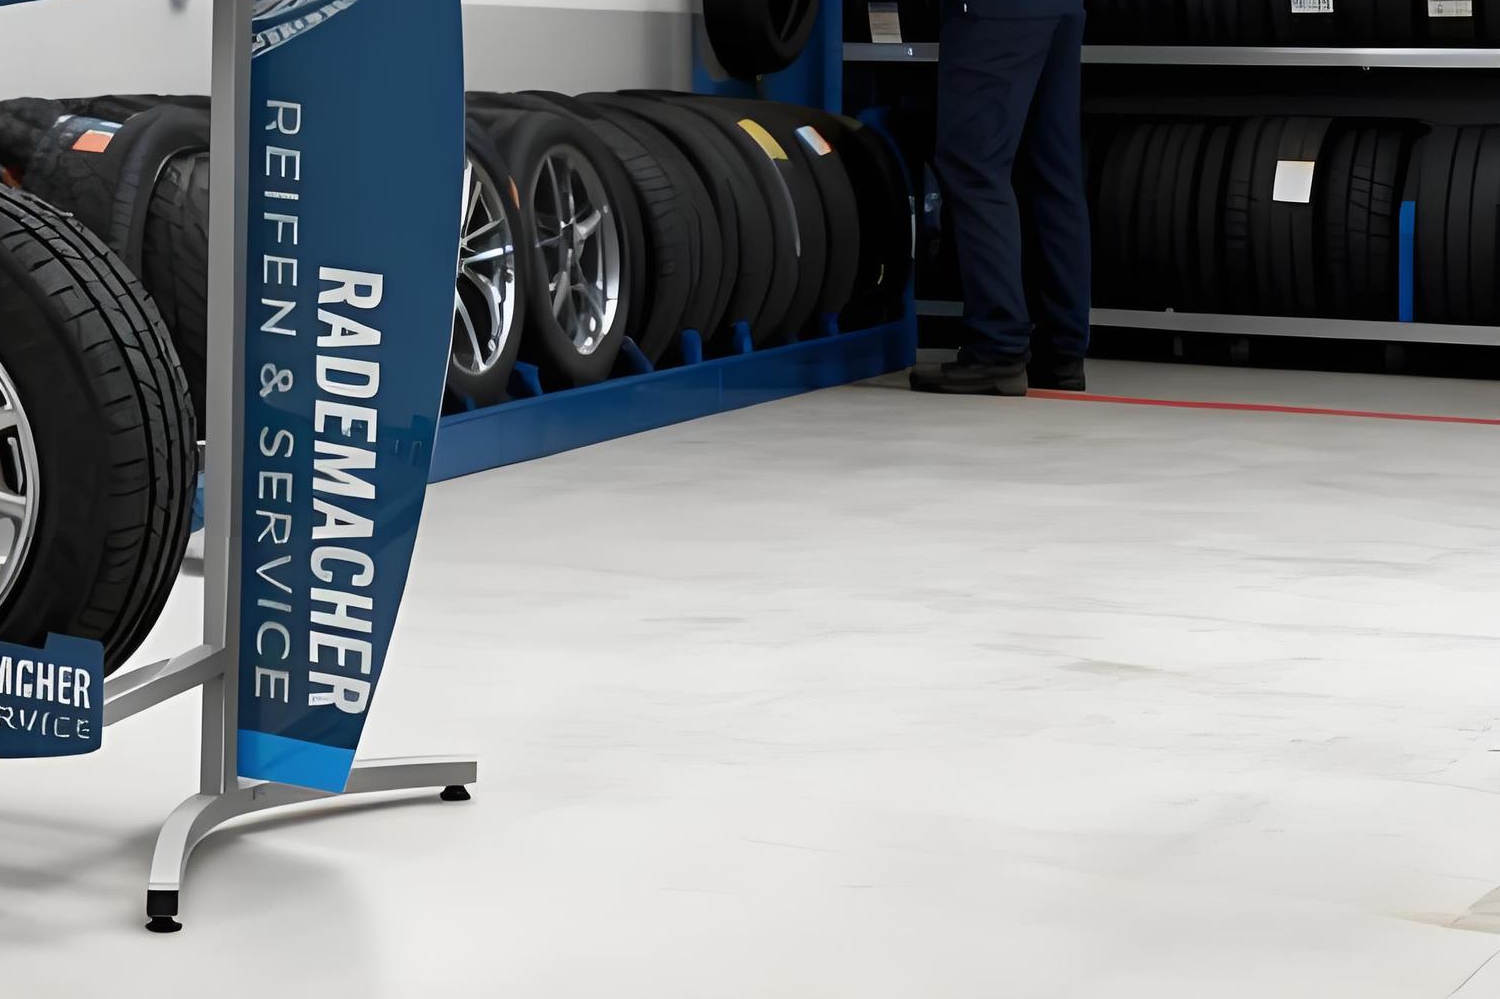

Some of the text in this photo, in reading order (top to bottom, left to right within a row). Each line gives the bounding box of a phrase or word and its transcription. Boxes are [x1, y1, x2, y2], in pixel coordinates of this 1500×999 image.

[254, 99, 302, 703] REIFEN & SERVICE
[308, 266, 384, 714] RADEMACHER
